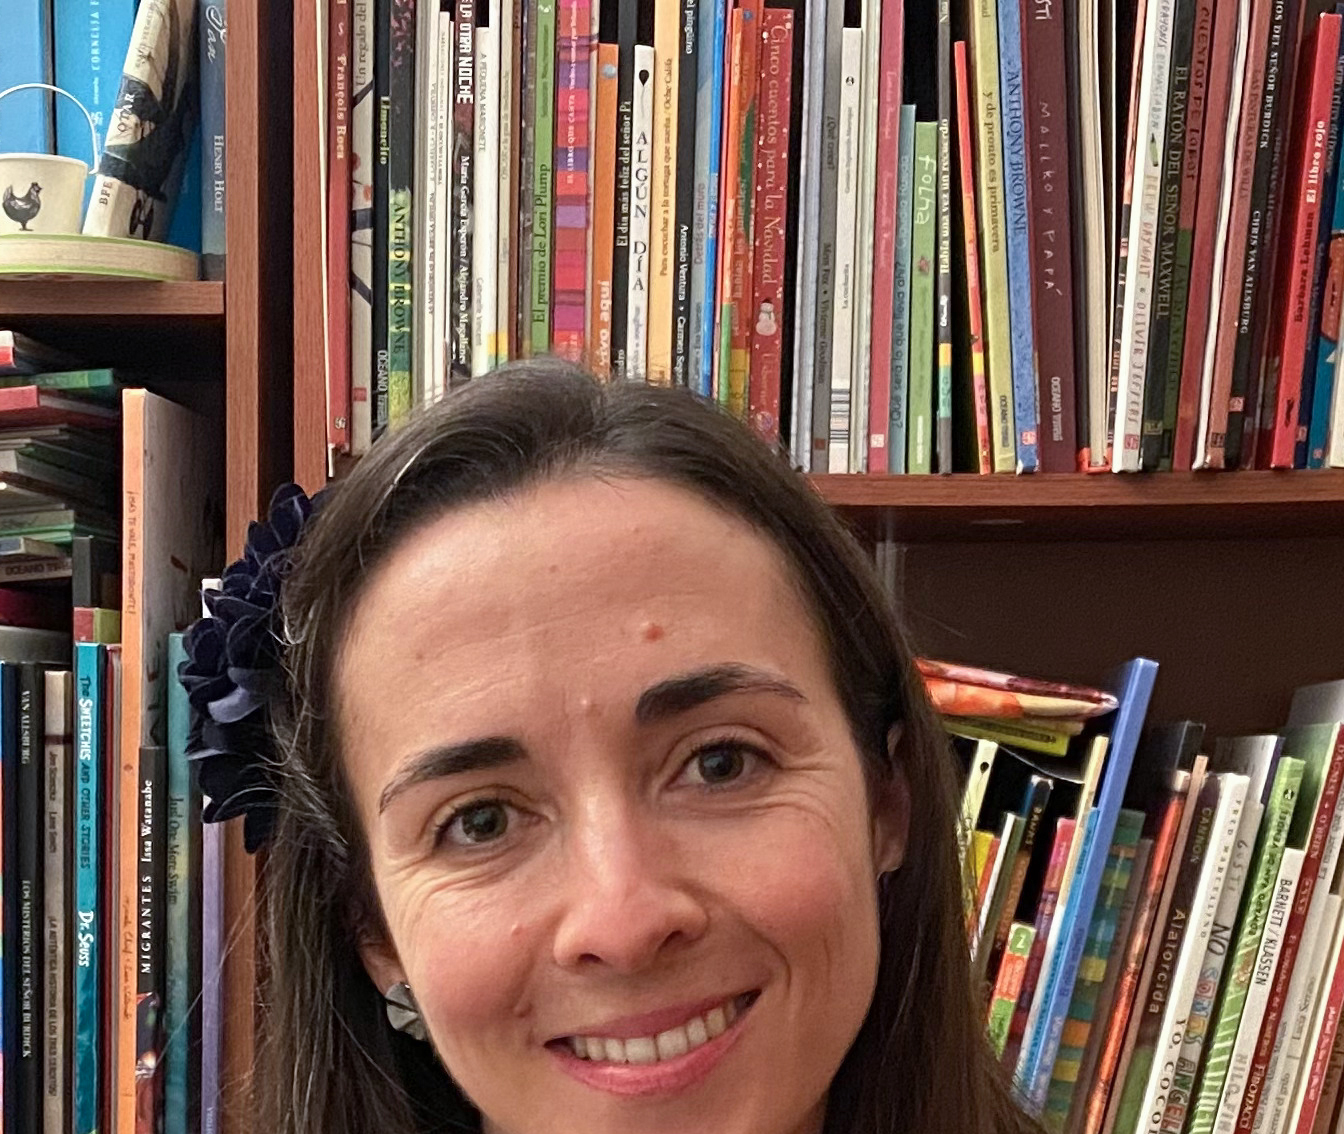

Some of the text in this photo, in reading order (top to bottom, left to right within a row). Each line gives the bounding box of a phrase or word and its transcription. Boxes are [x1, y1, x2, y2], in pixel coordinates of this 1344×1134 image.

[334, 54, 348, 121] François
[457, 56, 474, 104] NOCHE
[1258, 25, 1281, 149] DEL SEÑOR BURDICK
[212, 134, 225, 212] HENRY HOLT
[617, 114, 630, 246] El día más feliz del señor
[631, 131, 649, 292] ALGÚN DÍA
[760, 25, 787, 285] Cinco cuentos para la Navidad
[939, 117, 950, 274] Había una vez un recuerdo
[983, 103, 1002, 252] de pronto es primavera
[1006, 71, 1027, 236] ANTHONY BROWNE
[1155, 65, 1189, 320] EL RATÓN DEL SEÑOR MAXWELL
[1306, 120, 1326, 203] El libro rojo
[393, 203, 407, 354] ANTHONY BROWNE
[532, 163, 551, 323] El premio de Lori Plump
[596, 279, 611, 322] aquí
[677, 225, 689, 301] Antonio Ventura
[1239, 210, 1262, 335] CHRIS VAN ALLSBURG
[1293, 211, 1315, 322] Barbara Lehman
[77, 697, 92, 761] SNEETCHES
[140, 779, 153, 973] MIGRANTES Watanabe
[1253, 876, 1293, 987] BARNETT KLASSEN
[75, 909, 93, 967] Dr. Seuss
[1147, 908, 1186, 1016] Alatorcida
[1205, 921, 1231, 956] NO
